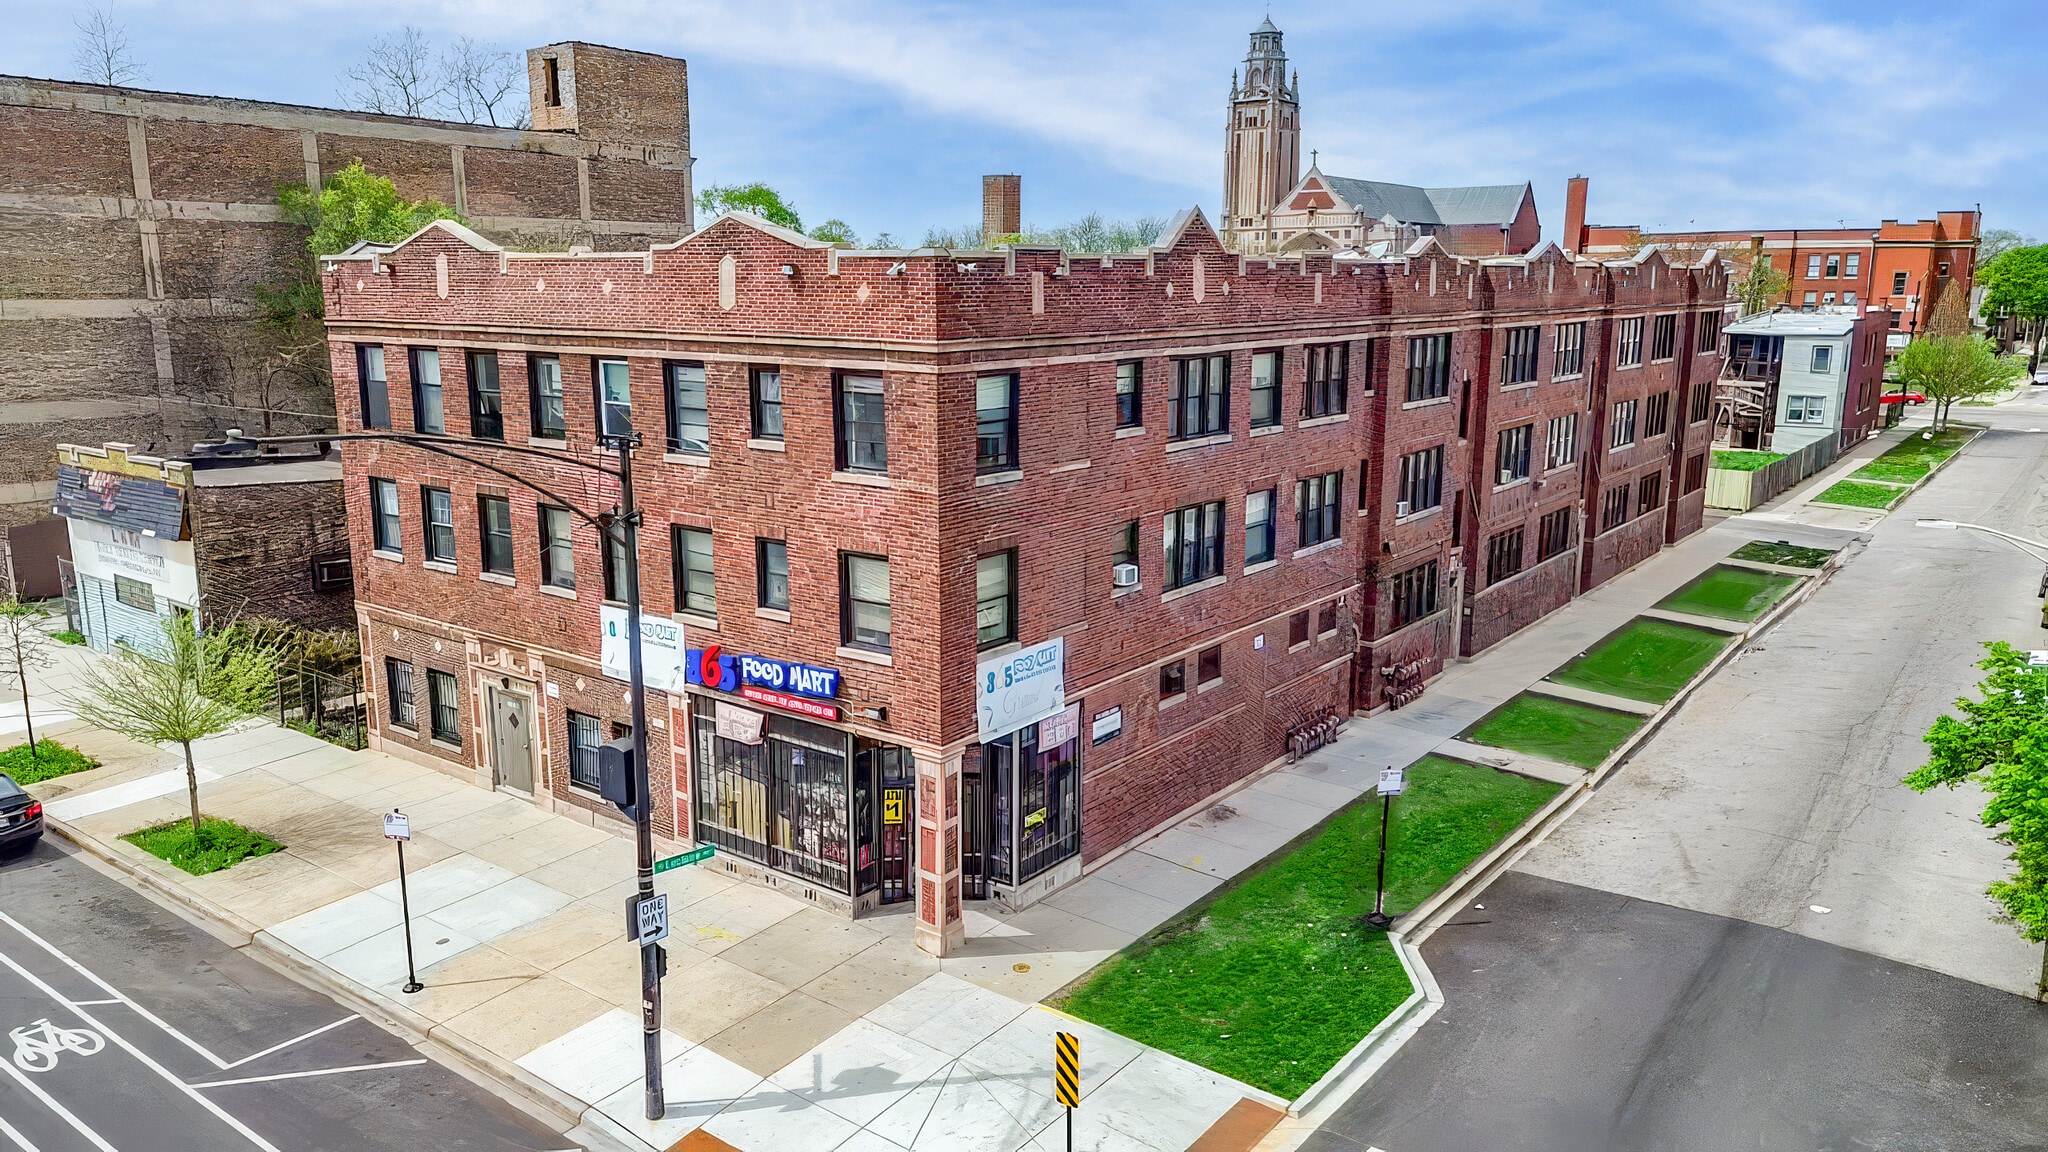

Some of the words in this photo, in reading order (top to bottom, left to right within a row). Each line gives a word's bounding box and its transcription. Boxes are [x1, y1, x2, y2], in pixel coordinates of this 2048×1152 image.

[741, 657, 784, 686] FOOD
[789, 665, 835, 695] MART
[642, 898, 664, 916] ONE
[641, 910, 664, 929] WAY
